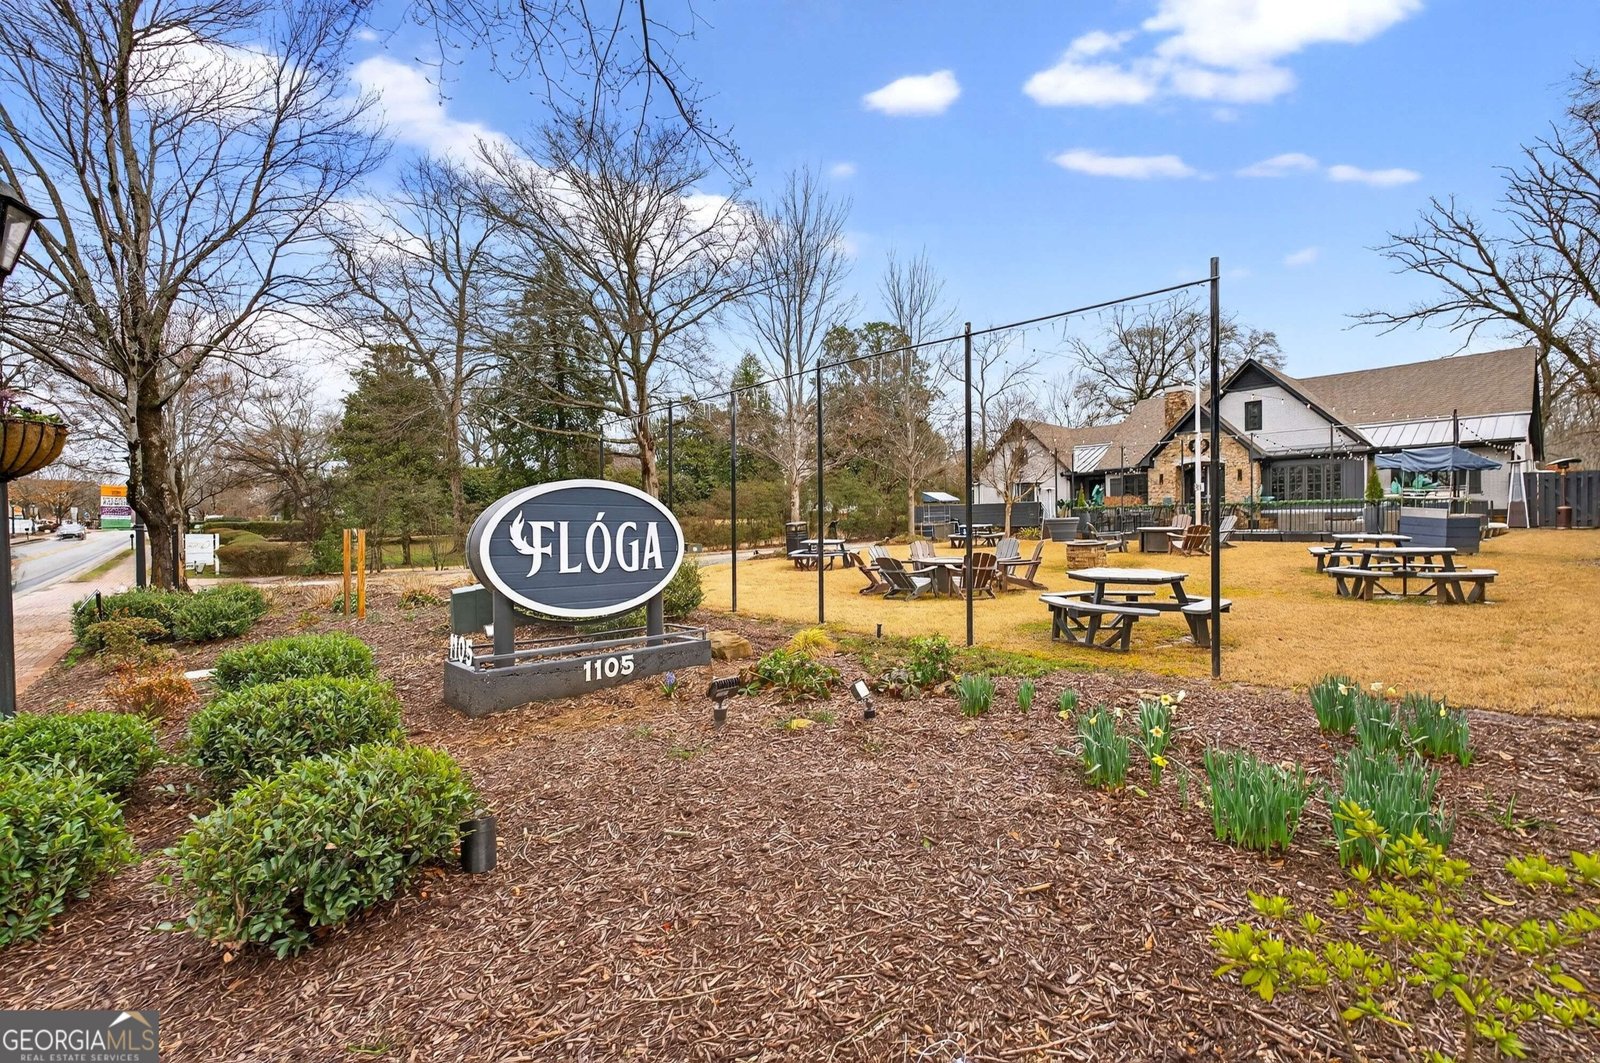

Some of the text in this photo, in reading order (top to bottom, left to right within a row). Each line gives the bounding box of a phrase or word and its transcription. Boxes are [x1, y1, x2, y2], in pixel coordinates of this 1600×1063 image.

[509, 511, 665, 578] FLÓGA
[450, 633, 473, 667] 1105
[583, 654, 635, 682] 1105
